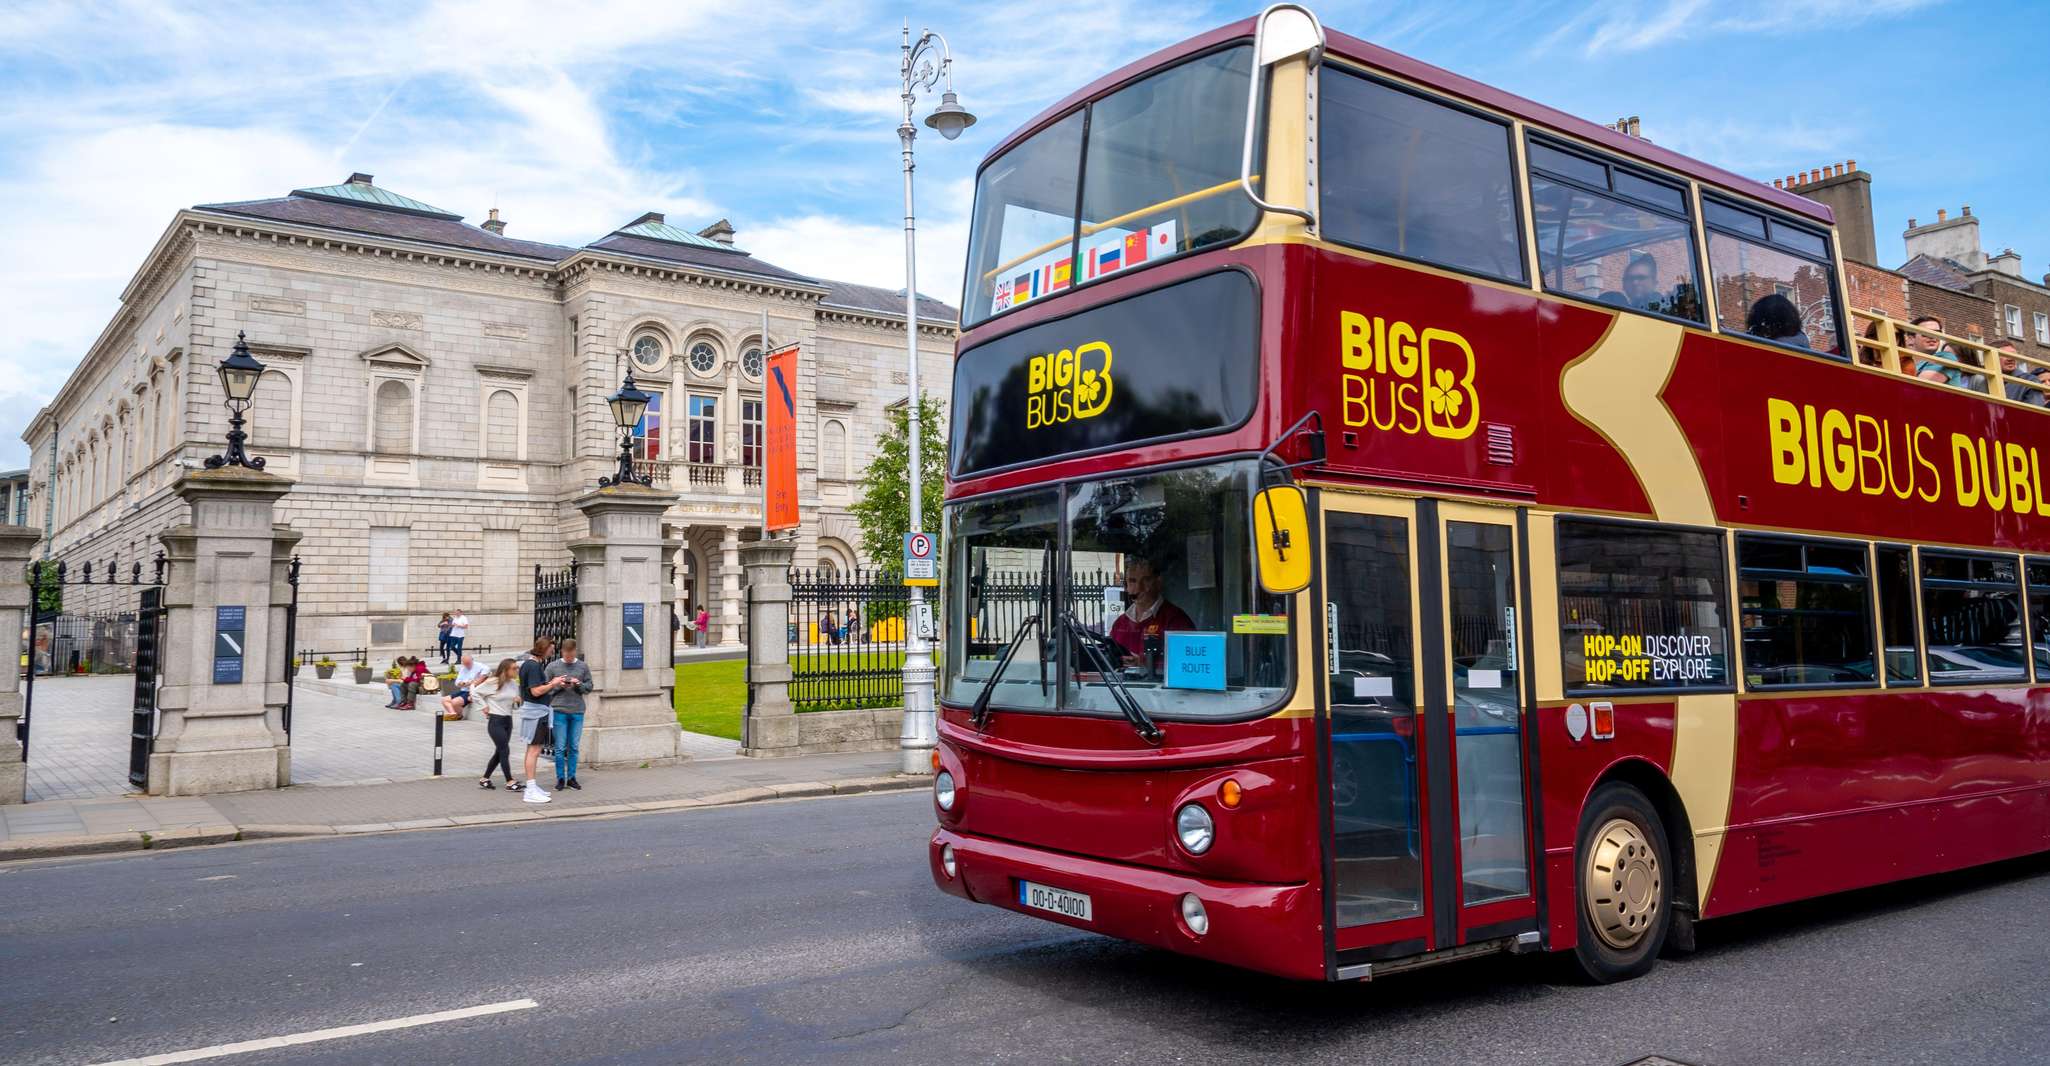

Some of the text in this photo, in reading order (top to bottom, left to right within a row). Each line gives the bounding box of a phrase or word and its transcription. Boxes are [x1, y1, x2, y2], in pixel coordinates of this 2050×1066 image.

[1340, 310, 1419, 378] BIG
[1028, 348, 1074, 394] BIG
[1027, 388, 1072, 429] BUS
[1342, 373, 1422, 434] BUS
[1951, 432, 2050, 517] DUBL
[916, 538, 926, 554] P
[921, 607, 928, 617] P
[1185, 645, 1207, 657] BLUE
[1583, 634, 1712, 657] HOP-ON DISCOVER
[1182, 663, 1211, 675] ROUTE
[1585, 658, 1713, 682] HOP-OFF EXPLORE
[1032, 888, 1085, 918] 00-D-40100
